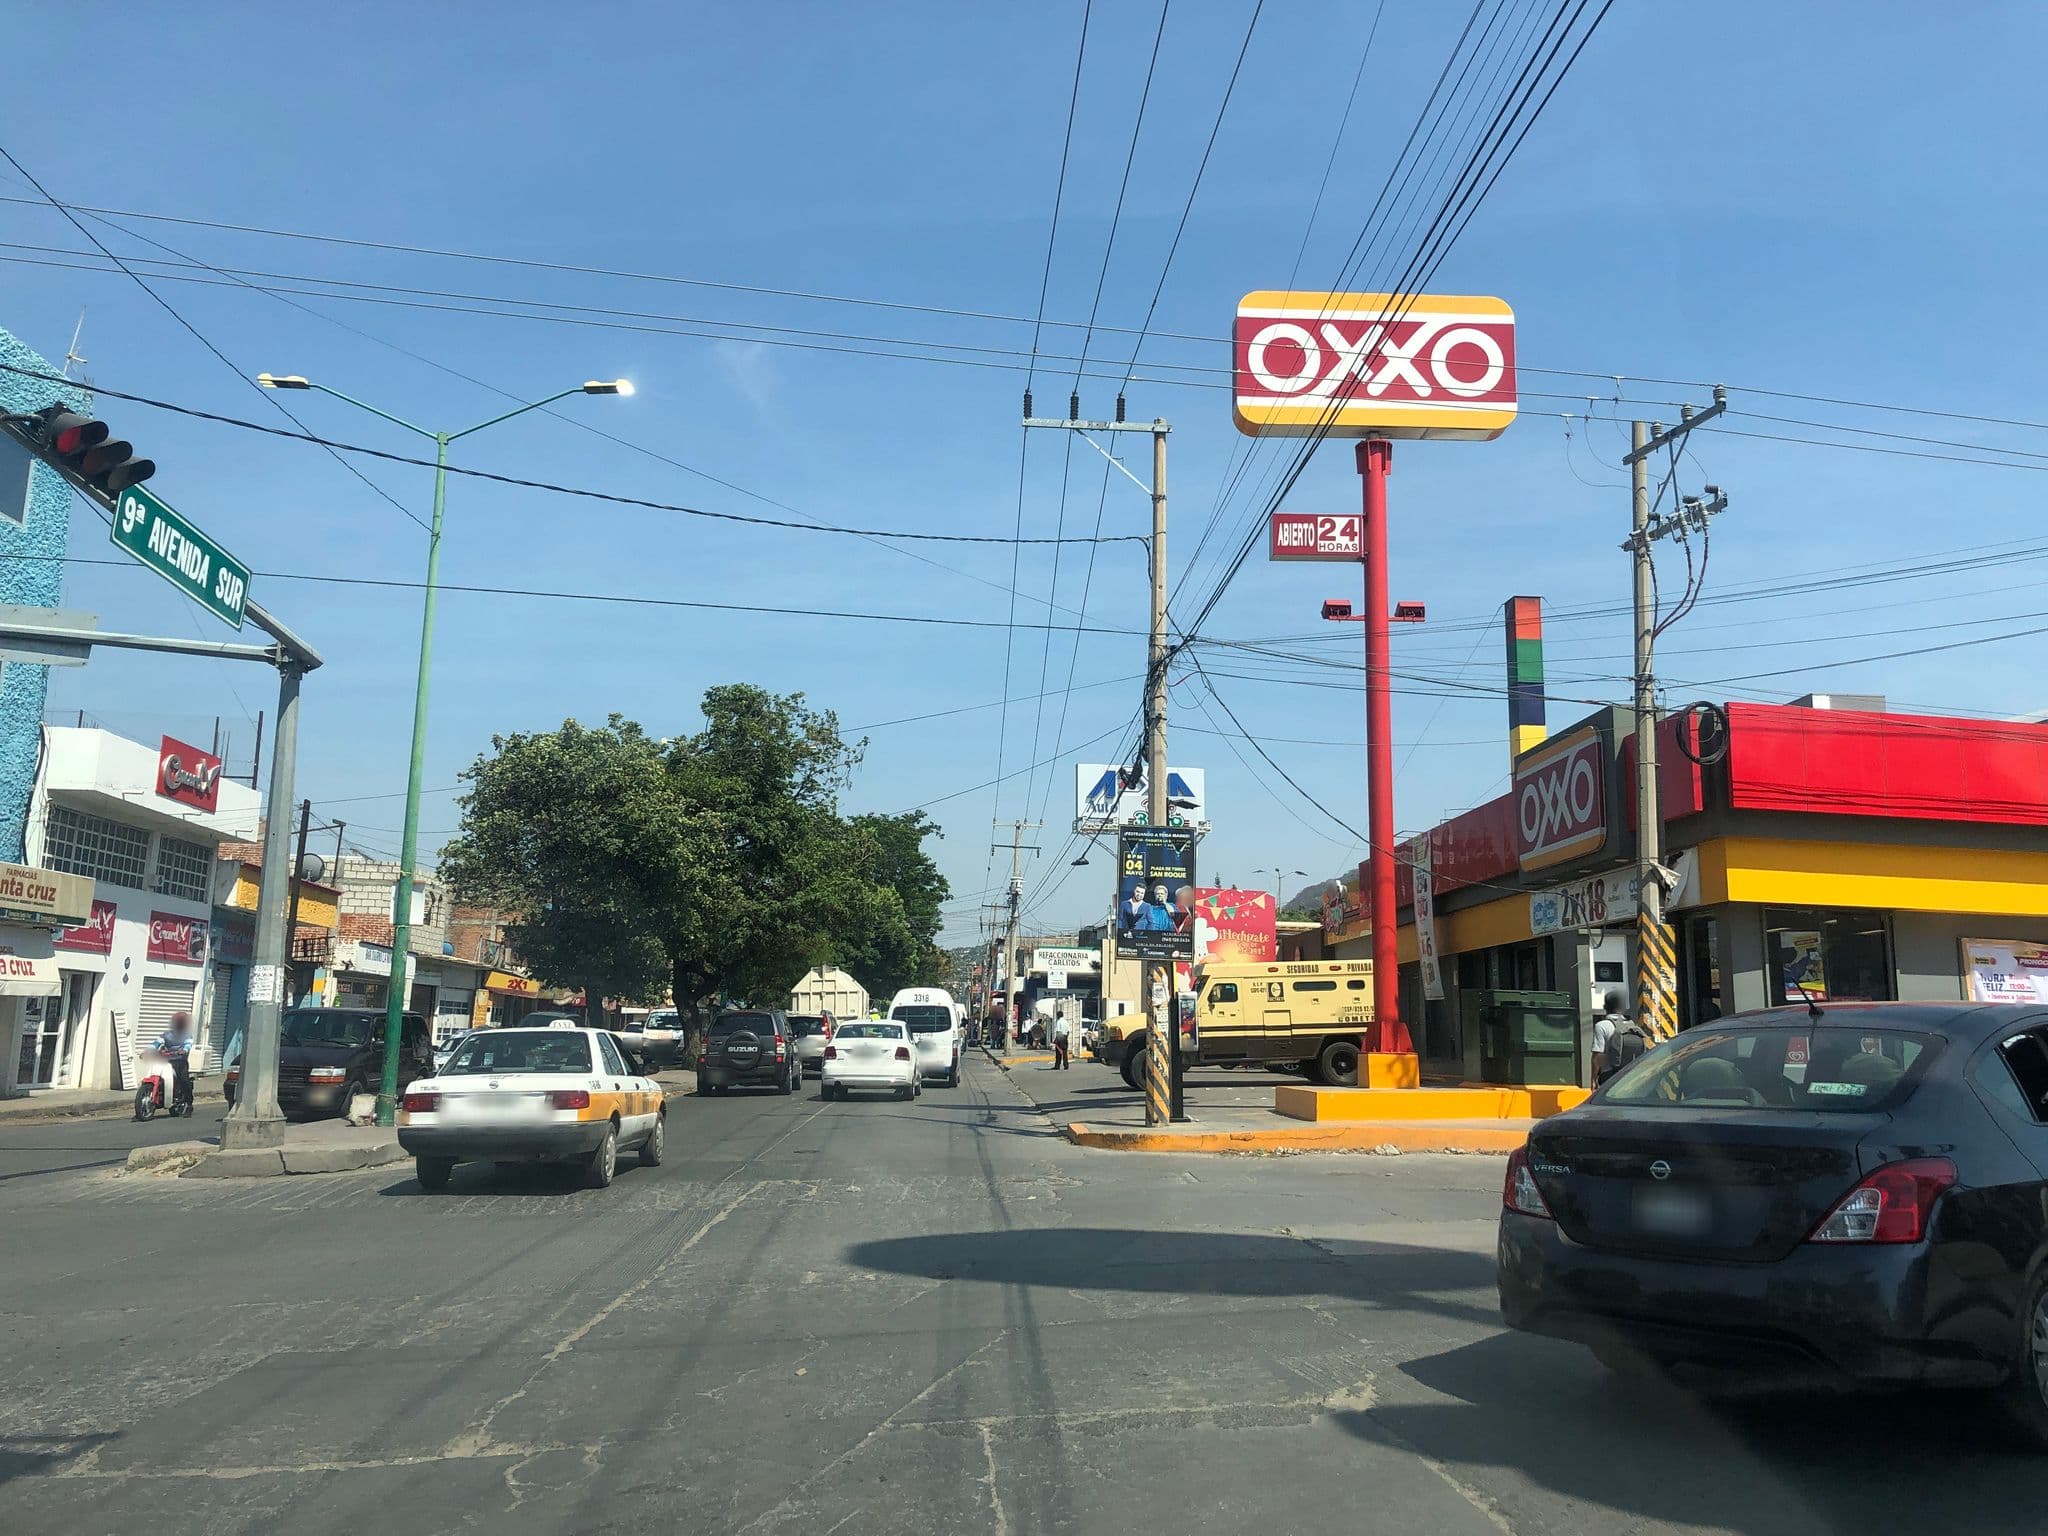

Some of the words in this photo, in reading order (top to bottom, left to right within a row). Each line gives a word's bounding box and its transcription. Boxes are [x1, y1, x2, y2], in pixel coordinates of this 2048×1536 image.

[1248, 322, 1504, 398] OXXO
[1278, 522, 1315, 548] ABIERTO
[1318, 517, 1358, 542] 24
[1318, 543, 1358, 552] HORAS
[148, 517, 210, 588] AVENIDA
[215, 566, 244, 612] SUR
[1520, 758, 1595, 842] OXXO
[1125, 859, 1143, 871] 04
[6, 868, 38, 880] FARMACIAS
[27, 882, 57, 902] cruz
[1039, 951, 1089, 960] REFACCIONARIA
[9, 959, 36, 976] cruz
[1048, 959, 1081, 967] CARLITOS
[1286, 964, 1319, 974] SEGURIDAD
[1347, 963, 1372, 972] PRIVADA
[507, 979, 528, 990] 2X1
[728, 1046, 758, 1054] SUZUKI
[1533, 1163, 1572, 1174] VERSA
